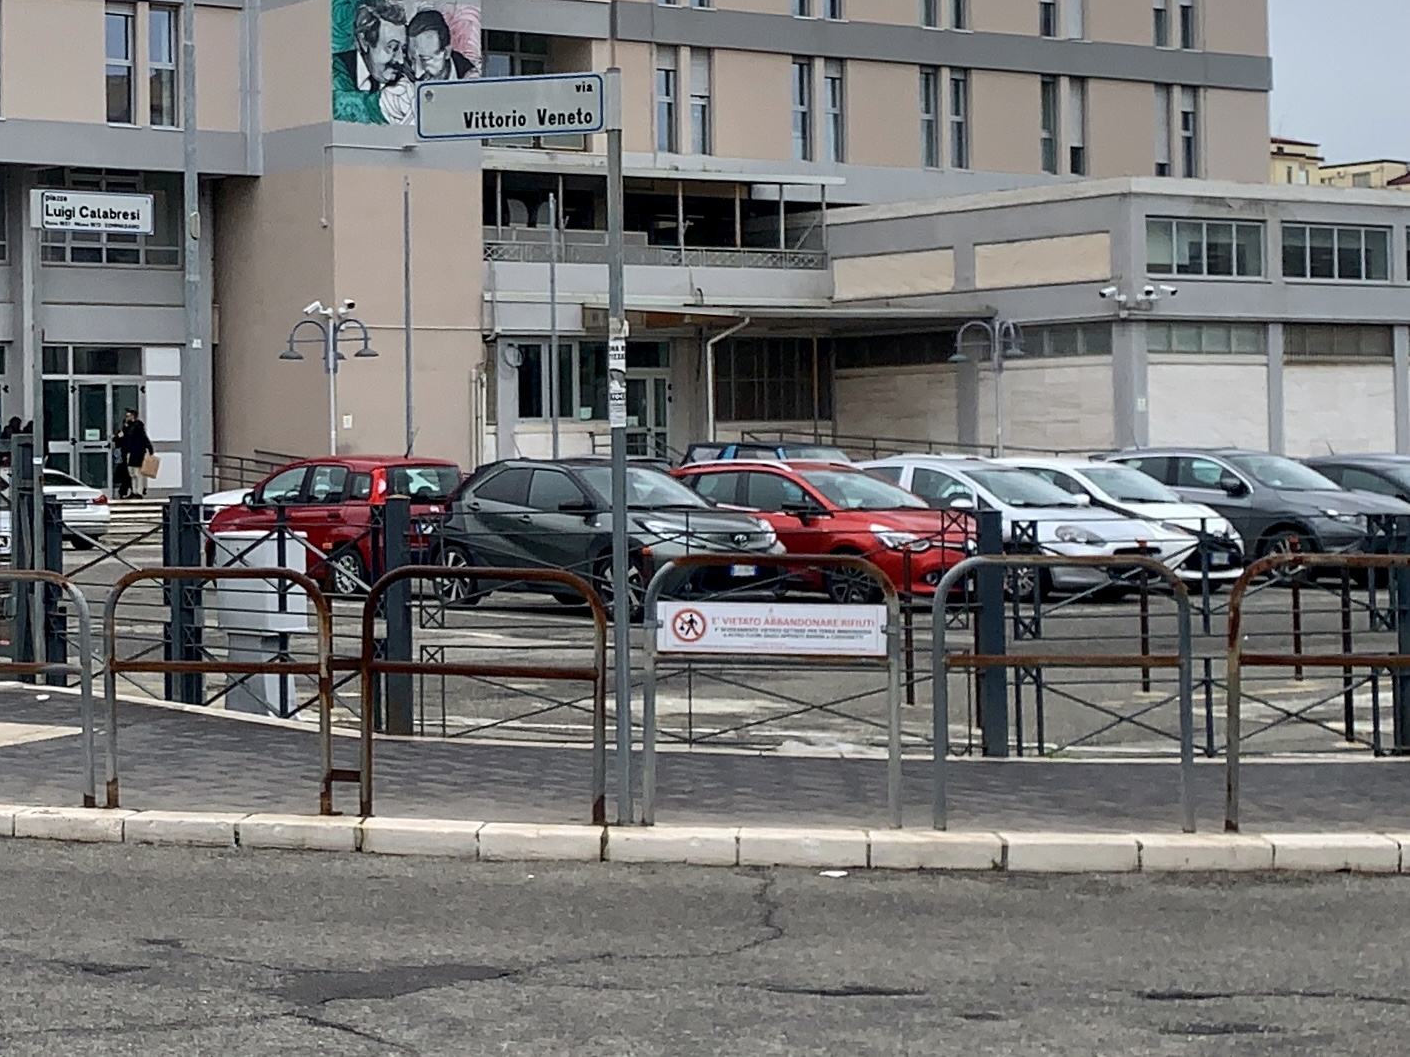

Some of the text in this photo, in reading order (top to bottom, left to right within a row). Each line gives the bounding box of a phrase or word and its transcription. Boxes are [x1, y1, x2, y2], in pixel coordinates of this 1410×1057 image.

[575, 81, 593, 93] via
[463, 107, 593, 129] Vittorio Veneto
[45, 194, 68, 202] piazza
[45, 204, 141, 221] Luigi Calabresi
[722, 616, 762, 626] VIETATO
[763, 617, 837, 627] ABBANDONARE
[841, 619, 875, 628] RIFIUTI
